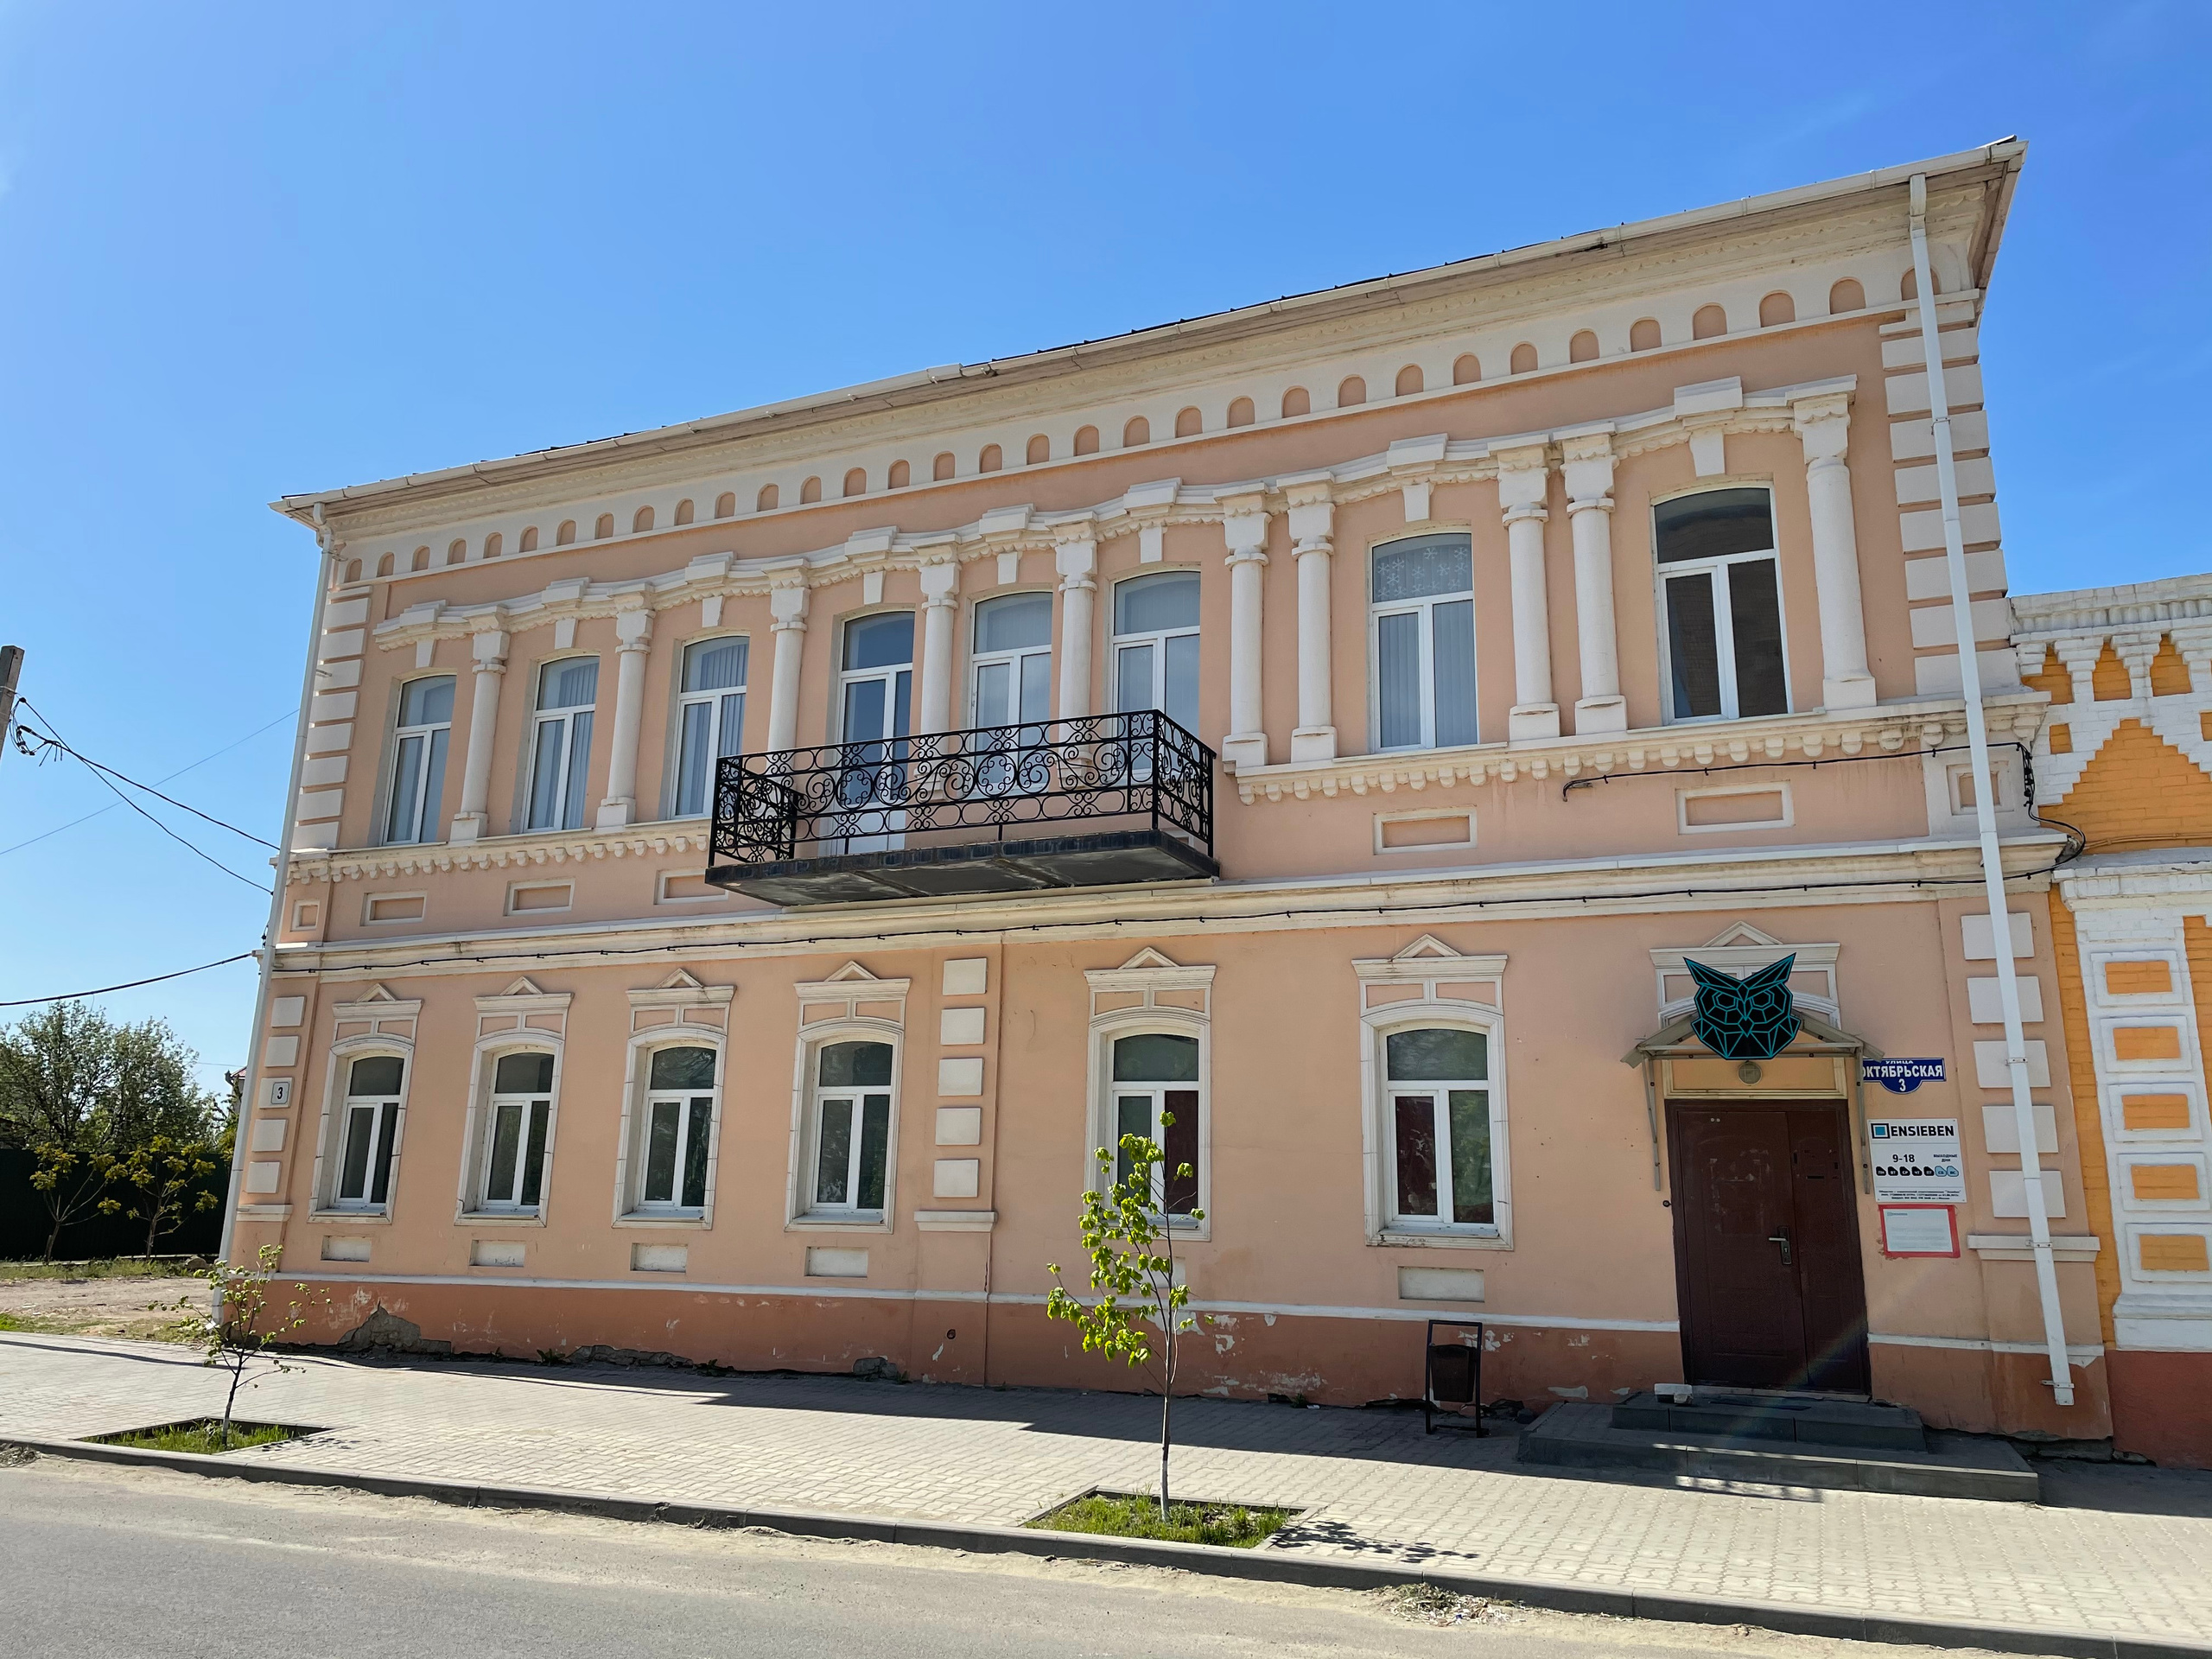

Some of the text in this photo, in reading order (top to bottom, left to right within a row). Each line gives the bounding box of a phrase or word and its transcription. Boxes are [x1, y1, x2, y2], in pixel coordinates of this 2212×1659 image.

[1898, 1078, 1906, 1091] 3
[276, 1087, 283, 1100] 3
[1891, 1125, 1955, 1137] ENSIEBEN
[1892, 1154, 1916, 1163] 9-18
